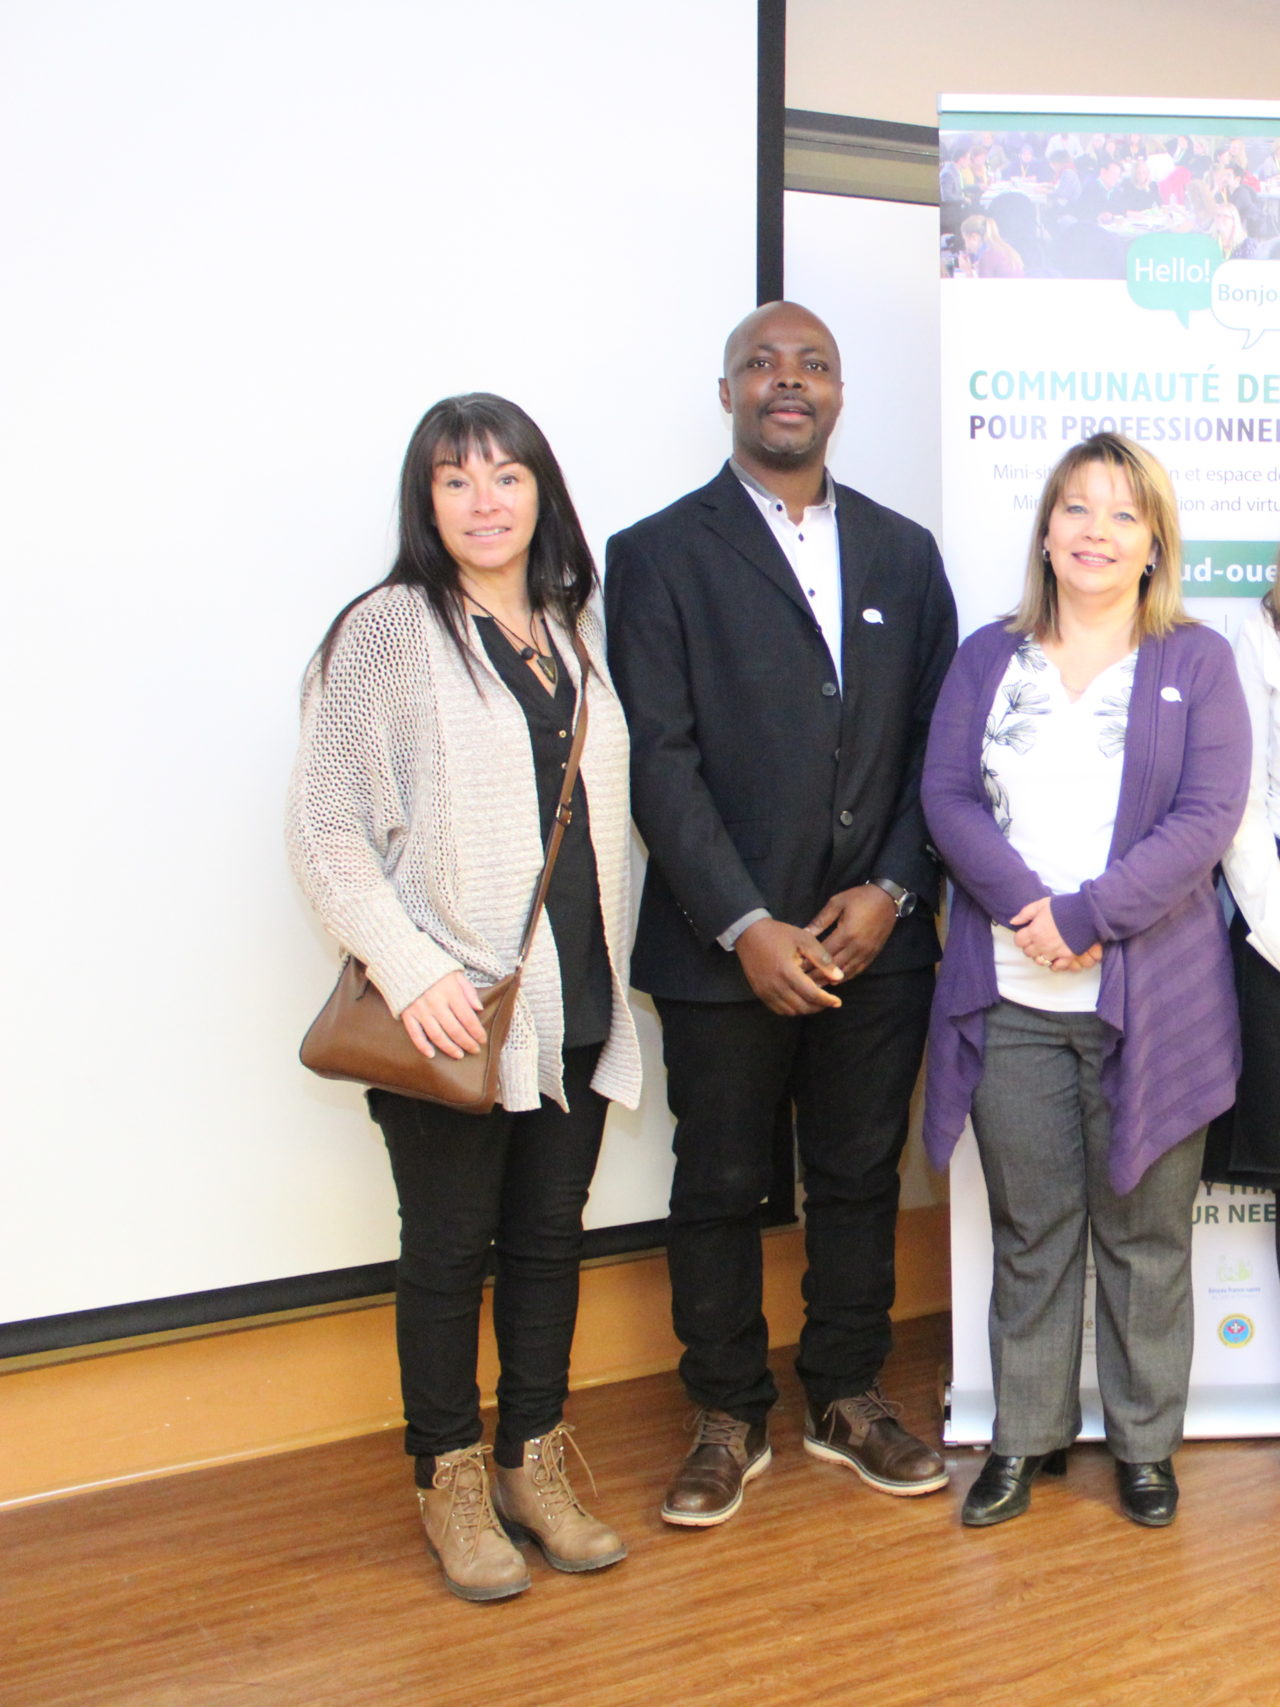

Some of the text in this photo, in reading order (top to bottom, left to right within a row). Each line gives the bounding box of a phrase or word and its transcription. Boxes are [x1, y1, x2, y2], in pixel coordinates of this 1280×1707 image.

[1135, 257, 1210, 283] Hello!
[968, 363, 1220, 402] COMMUNAUTÉ
[1237, 373, 1280, 404] DE
[969, 415, 1047, 440] POUR
[1185, 467, 1201, 481] et
[1206, 469, 1263, 485] espace
[1210, 496, 1241, 512] and
